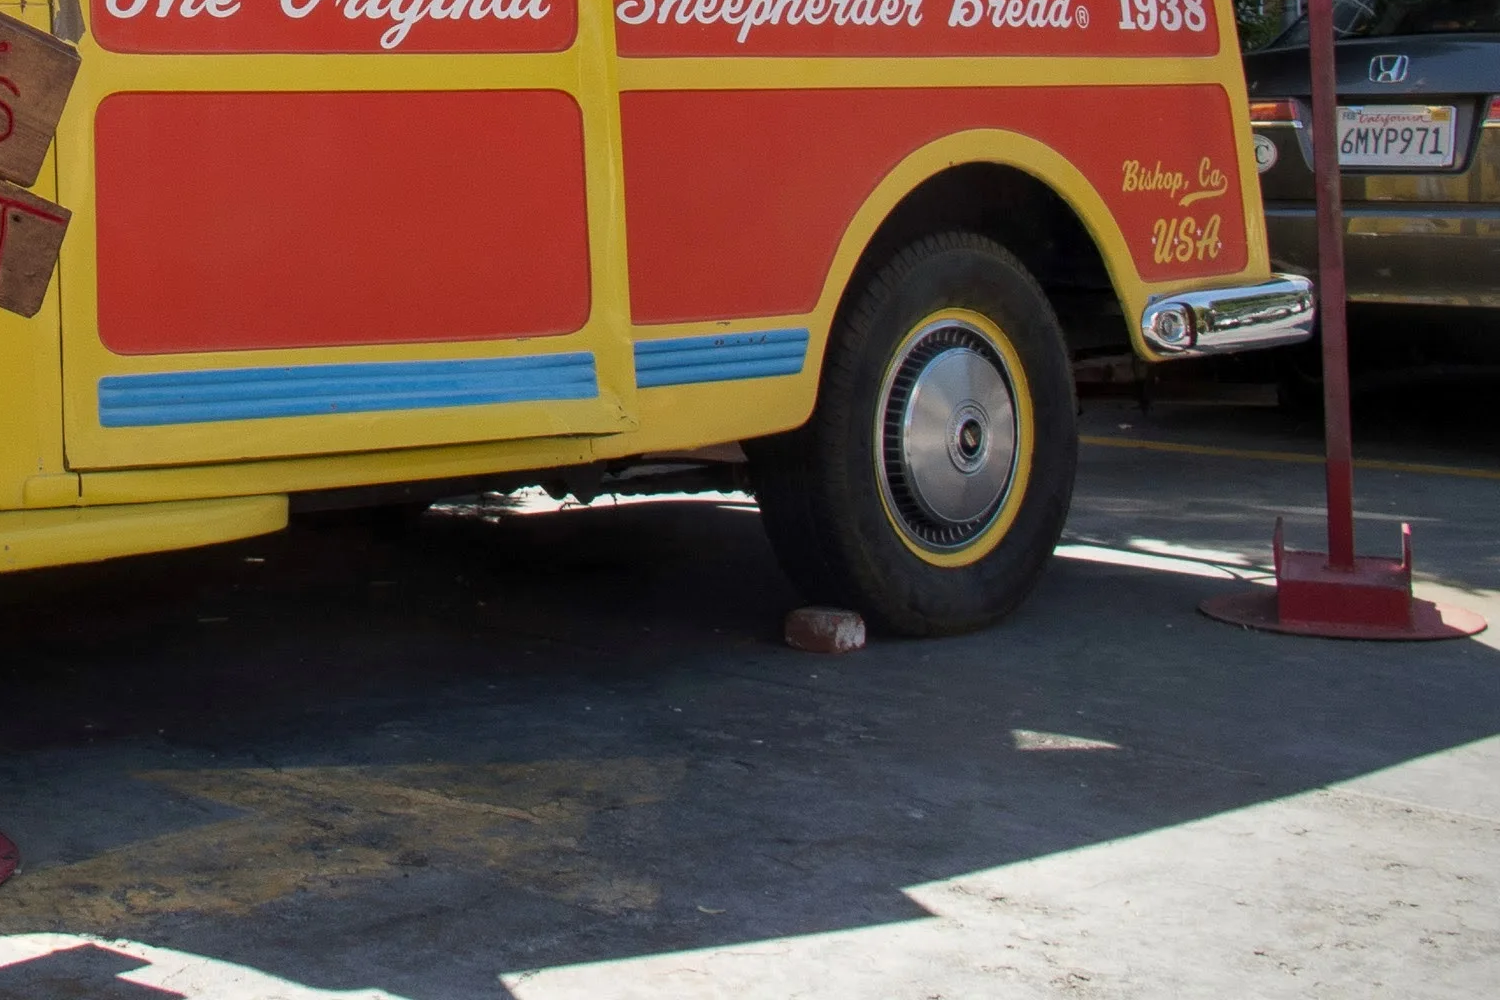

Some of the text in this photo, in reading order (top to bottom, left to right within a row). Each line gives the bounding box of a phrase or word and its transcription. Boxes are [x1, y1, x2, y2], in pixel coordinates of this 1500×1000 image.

[1341, 127, 1443, 155] 6MYP971
[1122, 159, 1189, 198] Bishop,
[1153, 214, 1221, 264] USA
